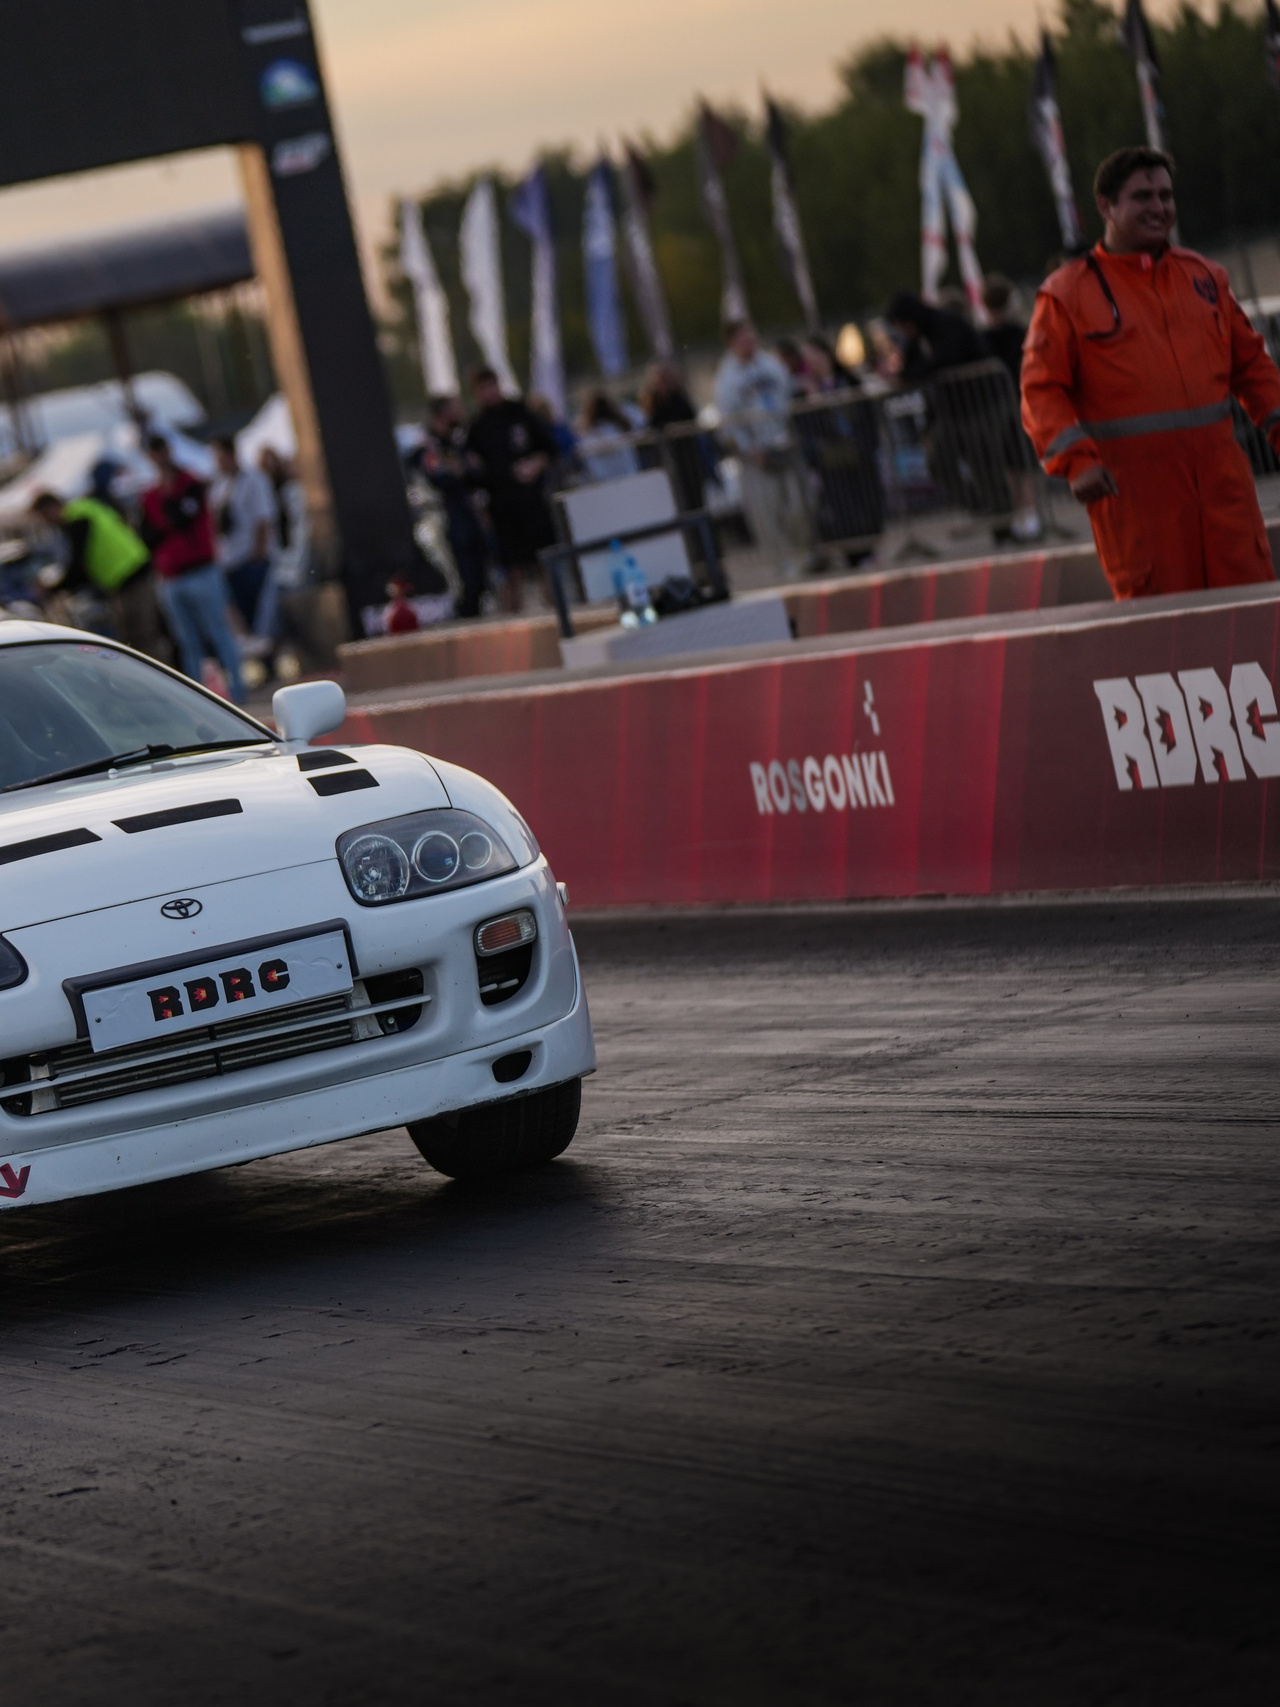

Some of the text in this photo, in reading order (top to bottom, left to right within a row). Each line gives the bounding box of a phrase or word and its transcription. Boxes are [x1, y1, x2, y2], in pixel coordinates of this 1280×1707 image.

[1093, 661, 1280, 790] RDRC
[749, 751, 895, 815] ROSGONKI
[146, 958, 291, 1022] RDRC
